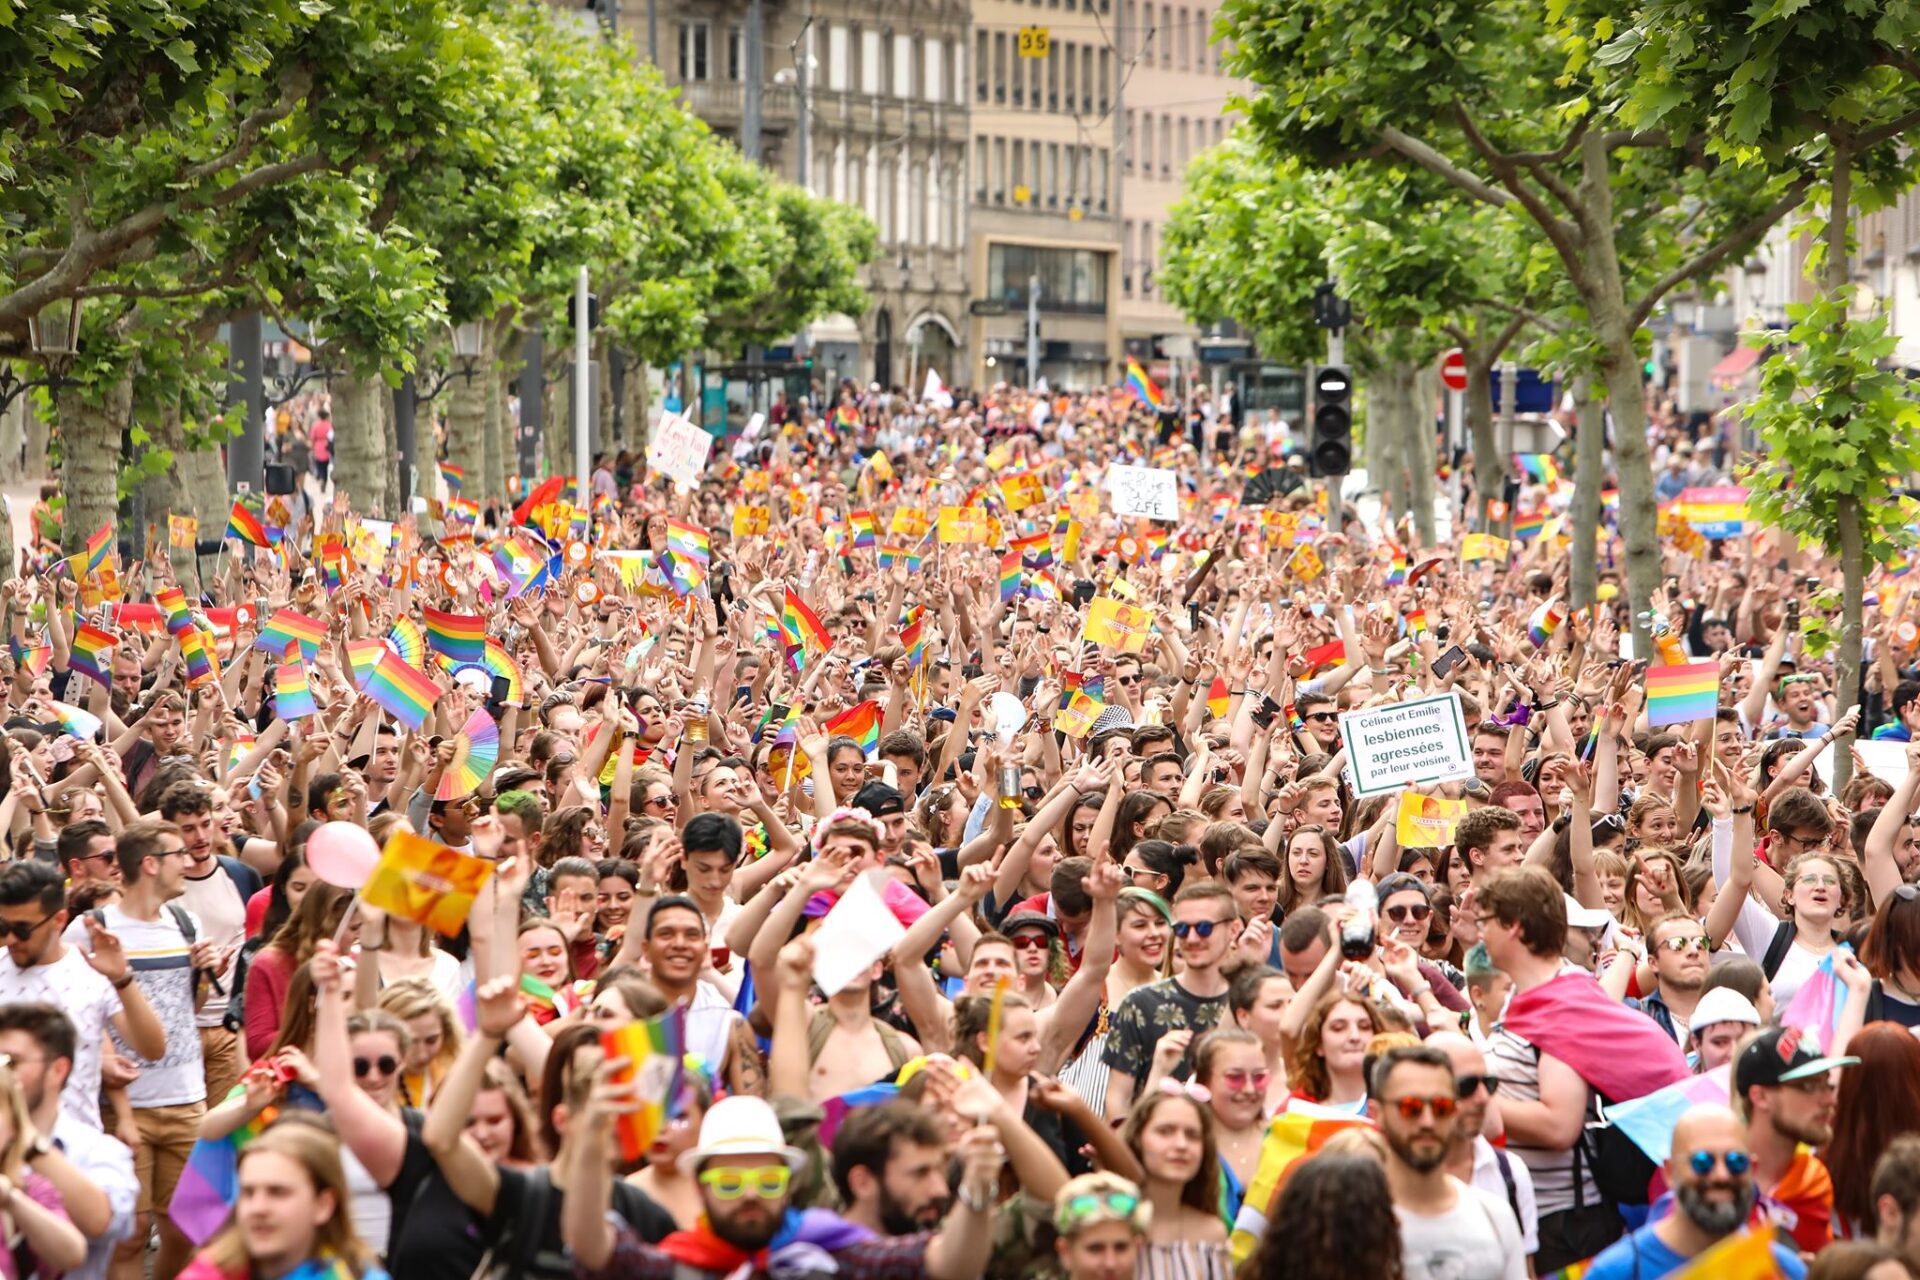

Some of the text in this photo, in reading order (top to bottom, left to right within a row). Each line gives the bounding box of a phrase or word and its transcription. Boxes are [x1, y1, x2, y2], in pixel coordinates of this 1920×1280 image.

[1022, 33, 1046, 50] 35
[1360, 705, 1441, 729] Céline et Emilie
[1364, 722, 1445, 746] lesbiennes,
[1371, 740, 1444, 764] agressées
[1370, 755, 1451, 779] par leur voisine
